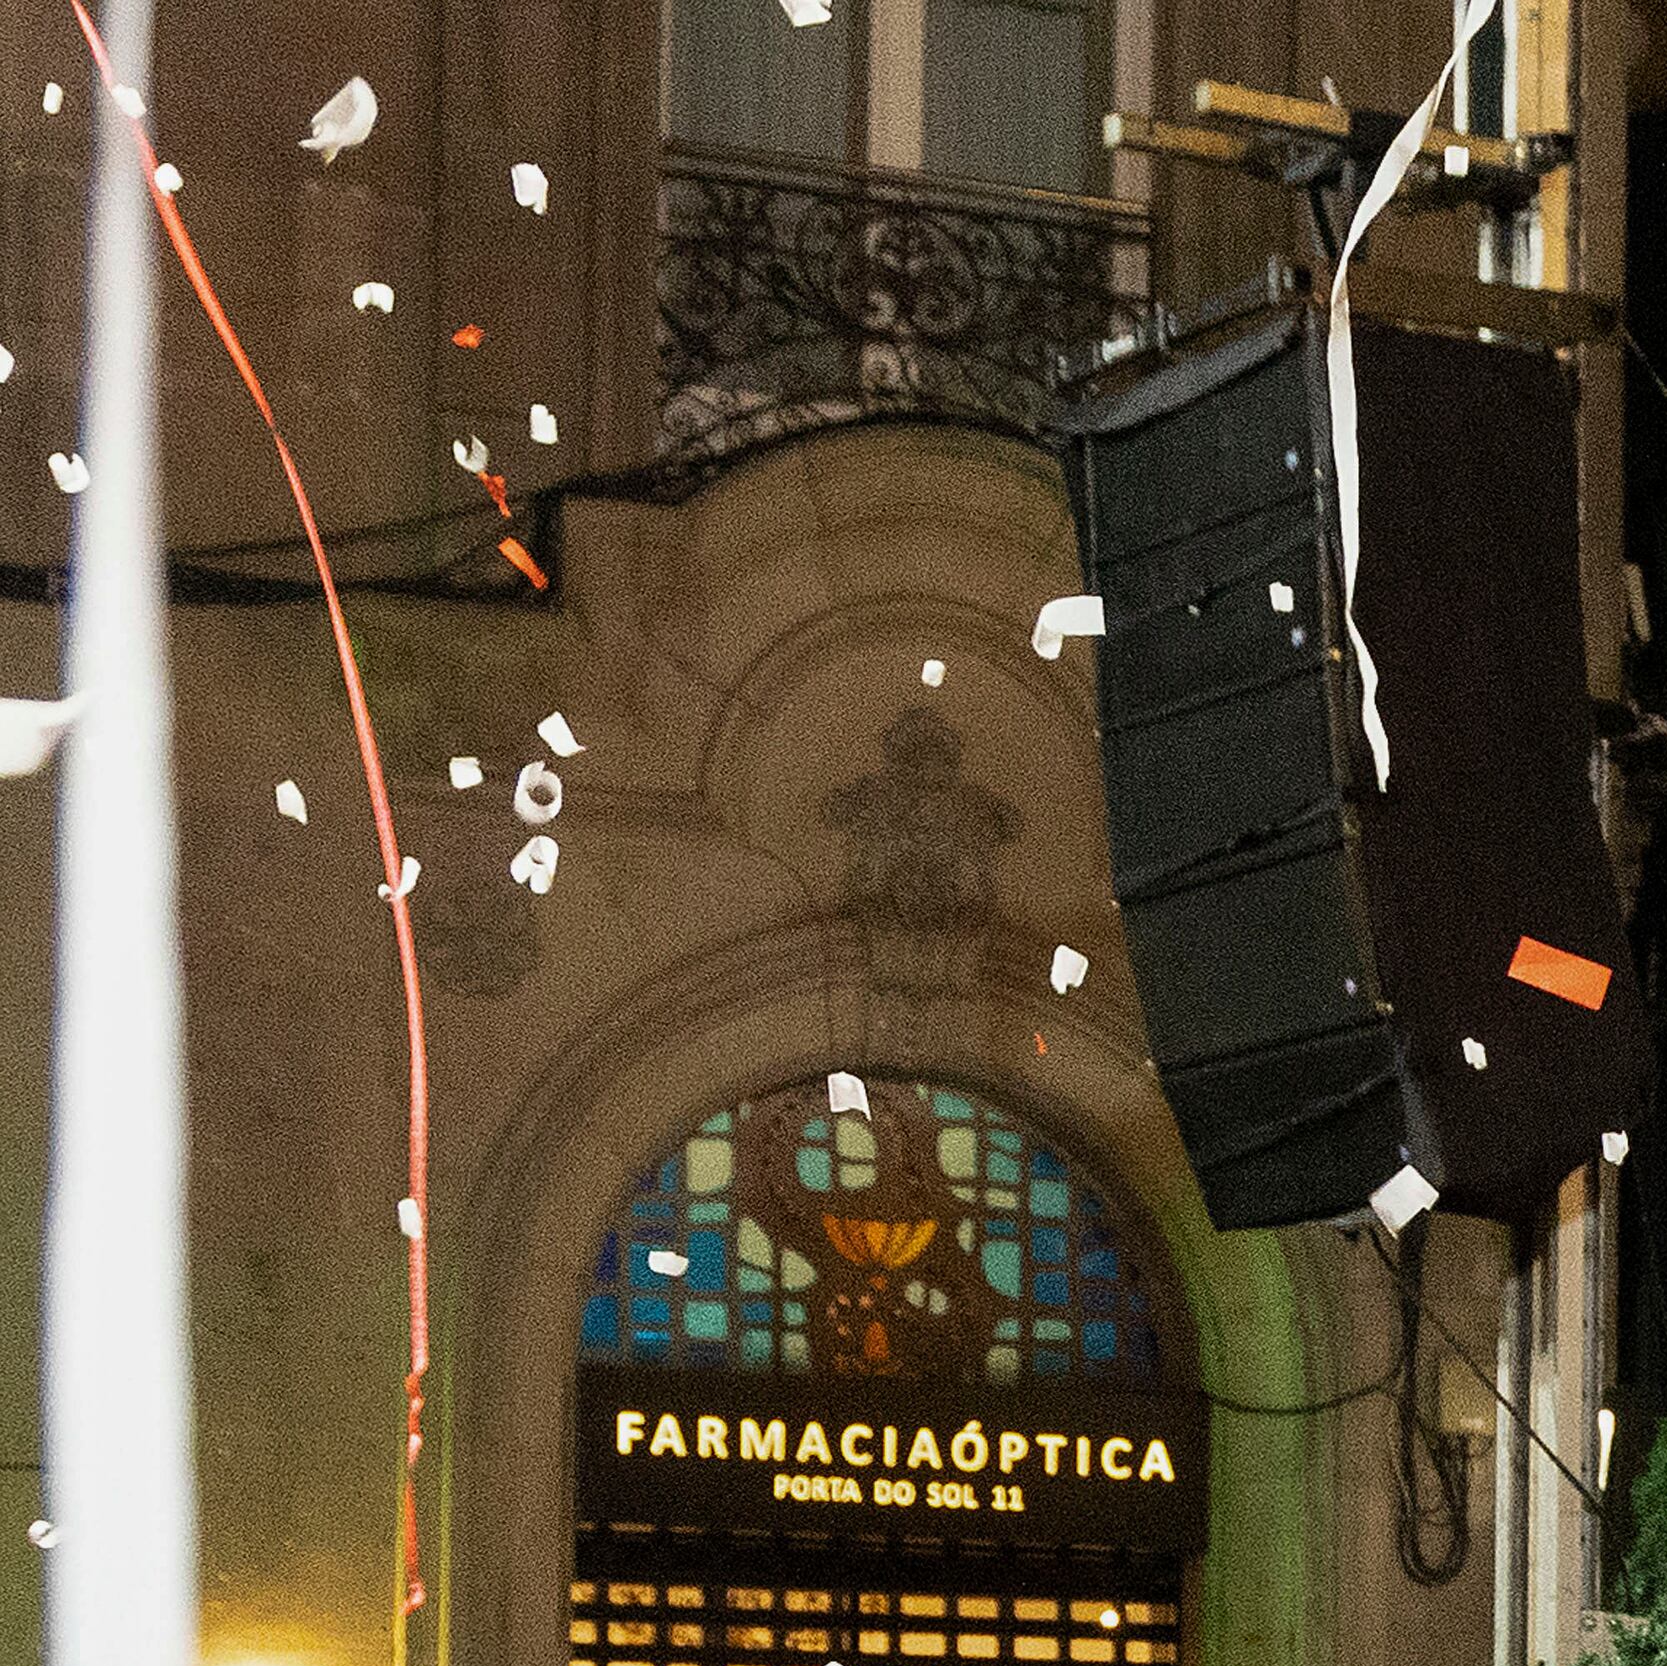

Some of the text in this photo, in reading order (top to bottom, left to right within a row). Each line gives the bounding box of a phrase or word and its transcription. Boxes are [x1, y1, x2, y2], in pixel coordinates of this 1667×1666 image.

[774, 1474, 1024, 1511] PORTA DO SOL 11
